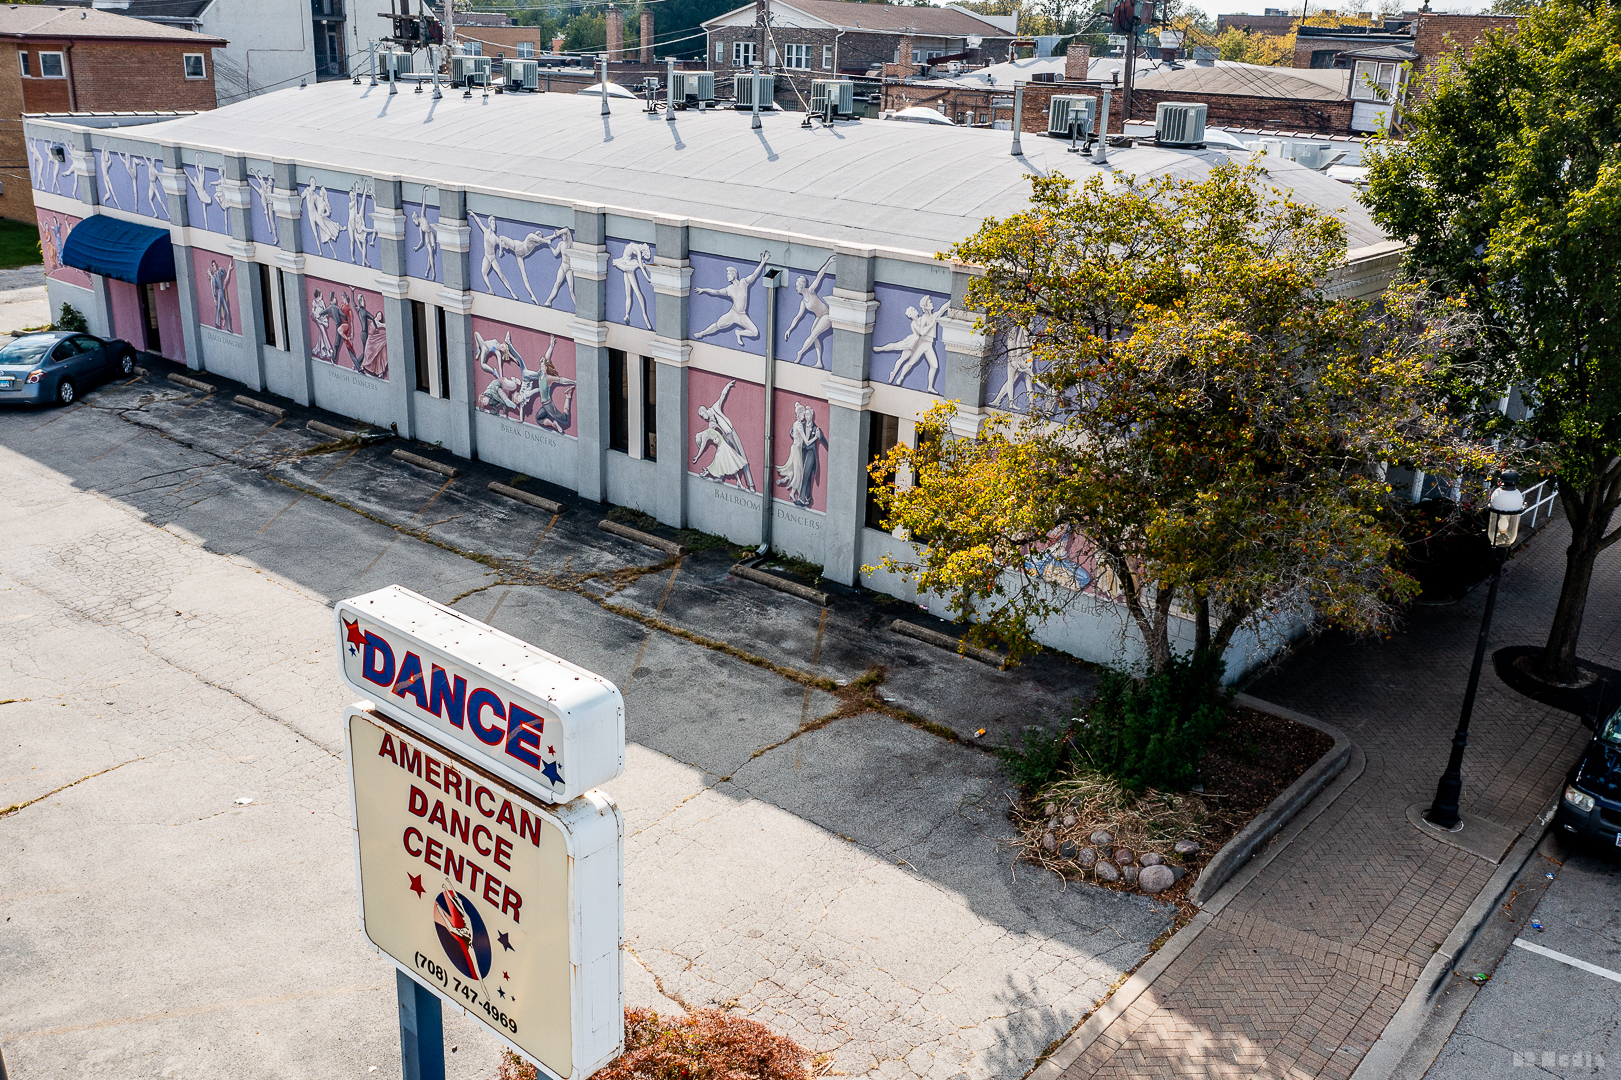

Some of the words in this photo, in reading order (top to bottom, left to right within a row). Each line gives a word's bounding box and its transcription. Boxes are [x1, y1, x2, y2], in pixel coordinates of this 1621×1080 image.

[222, 336, 243, 349] DANCERS
[327, 370, 350, 383] SPANISH
[352, 377, 378, 391] DANCERS
[501, 423, 522, 437] BREAK
[524, 430, 557, 448] DANCERS
[714, 488, 761, 512] BALLROOM
[777, 508, 820, 530] DANCERS
[362, 629, 545, 771] DANCE
[378, 732, 542, 848] AMERICAN
[408, 785, 514, 873] DANCE
[403, 826, 524, 924] CENTER
[414, 951, 449, 987] (708)
[452, 976, 519, 1034] 747-4969
